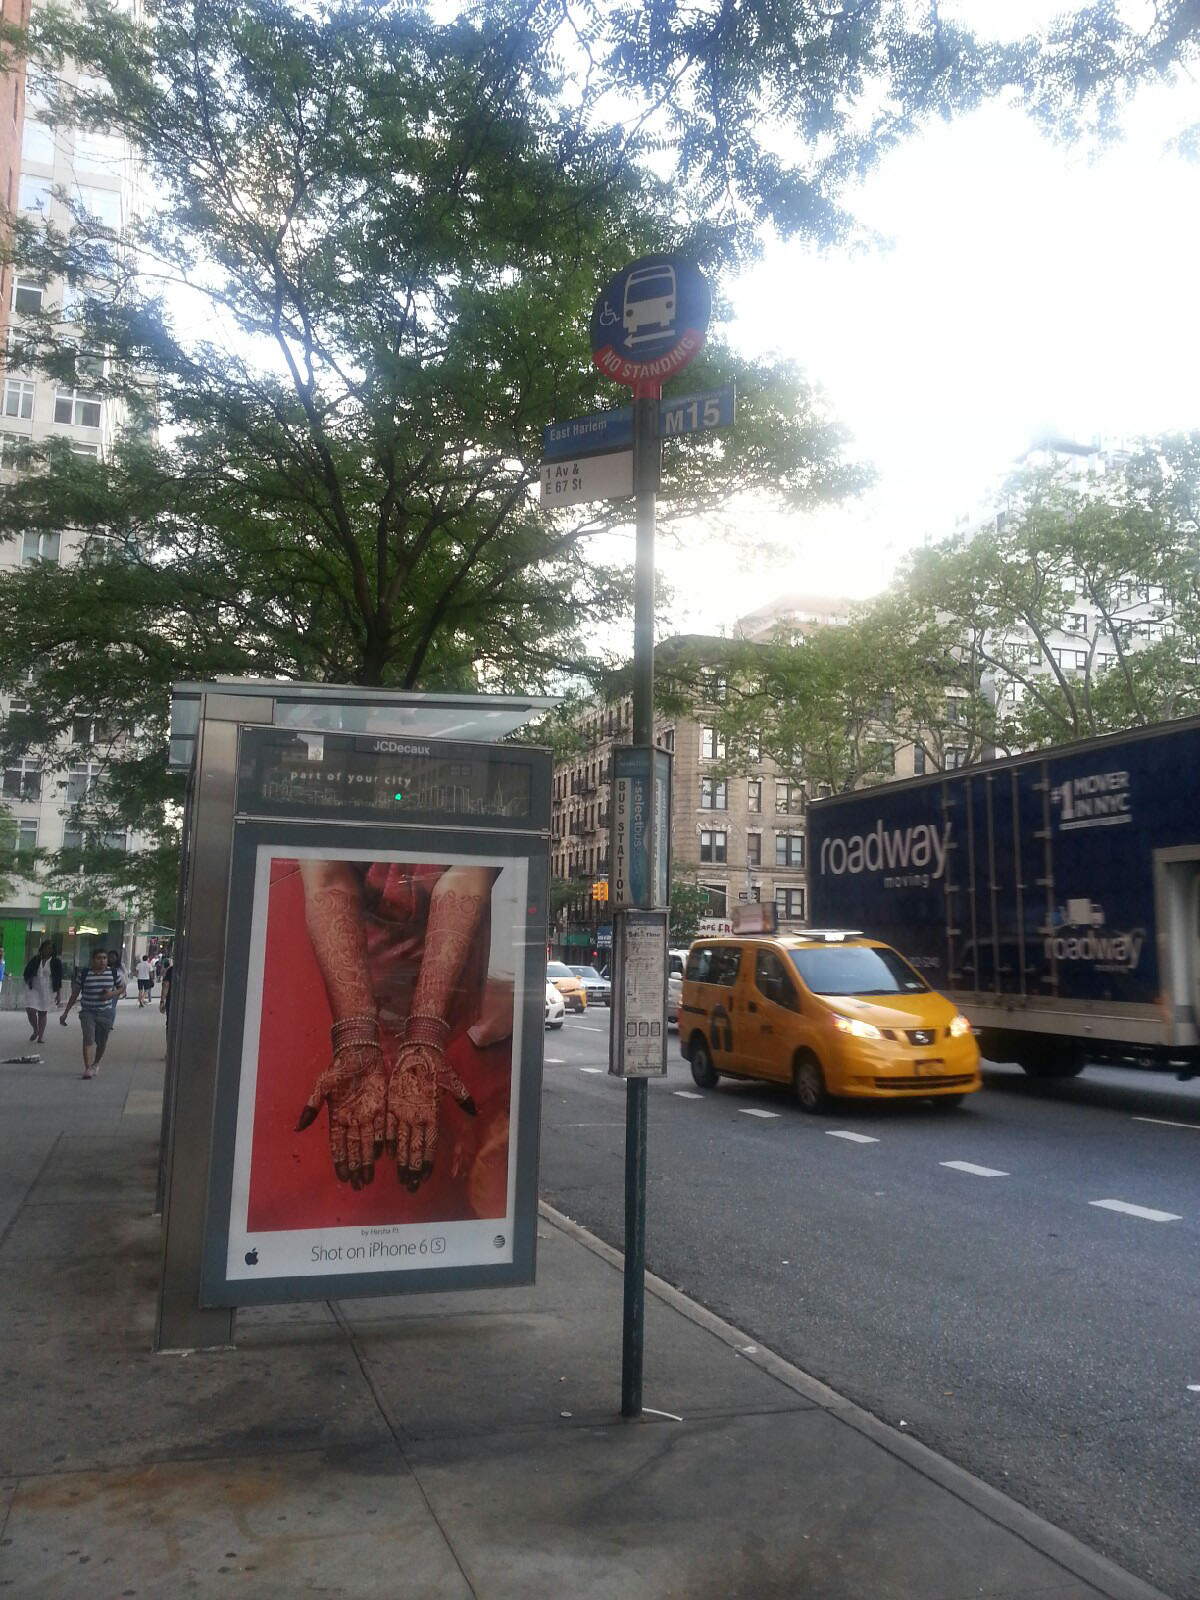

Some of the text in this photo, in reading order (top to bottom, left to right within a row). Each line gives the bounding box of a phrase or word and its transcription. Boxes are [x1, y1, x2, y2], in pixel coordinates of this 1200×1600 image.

[602, 337, 695, 379] NO STANDING
[665, 398, 720, 434] M15
[550, 419, 607, 441] East Harlem
[545, 463, 580, 479] 1 Av &
[545, 478, 582, 495] E 67 St
[373, 740, 431, 756] JCDecaux
[290, 771, 412, 786] part of your city
[616, 781, 626, 902] BUS STATION
[820, 819, 952, 880] roadway
[44, 895, 67, 911] TD
[1045, 928, 1147, 969] roadway
[361, 1228, 369, 1237] by
[311, 1244, 343, 1262] Shot
[347, 1247, 365, 1259] on
[369, 1240, 416, 1257] iPhone
[419, 1240, 428, 1254] 6
